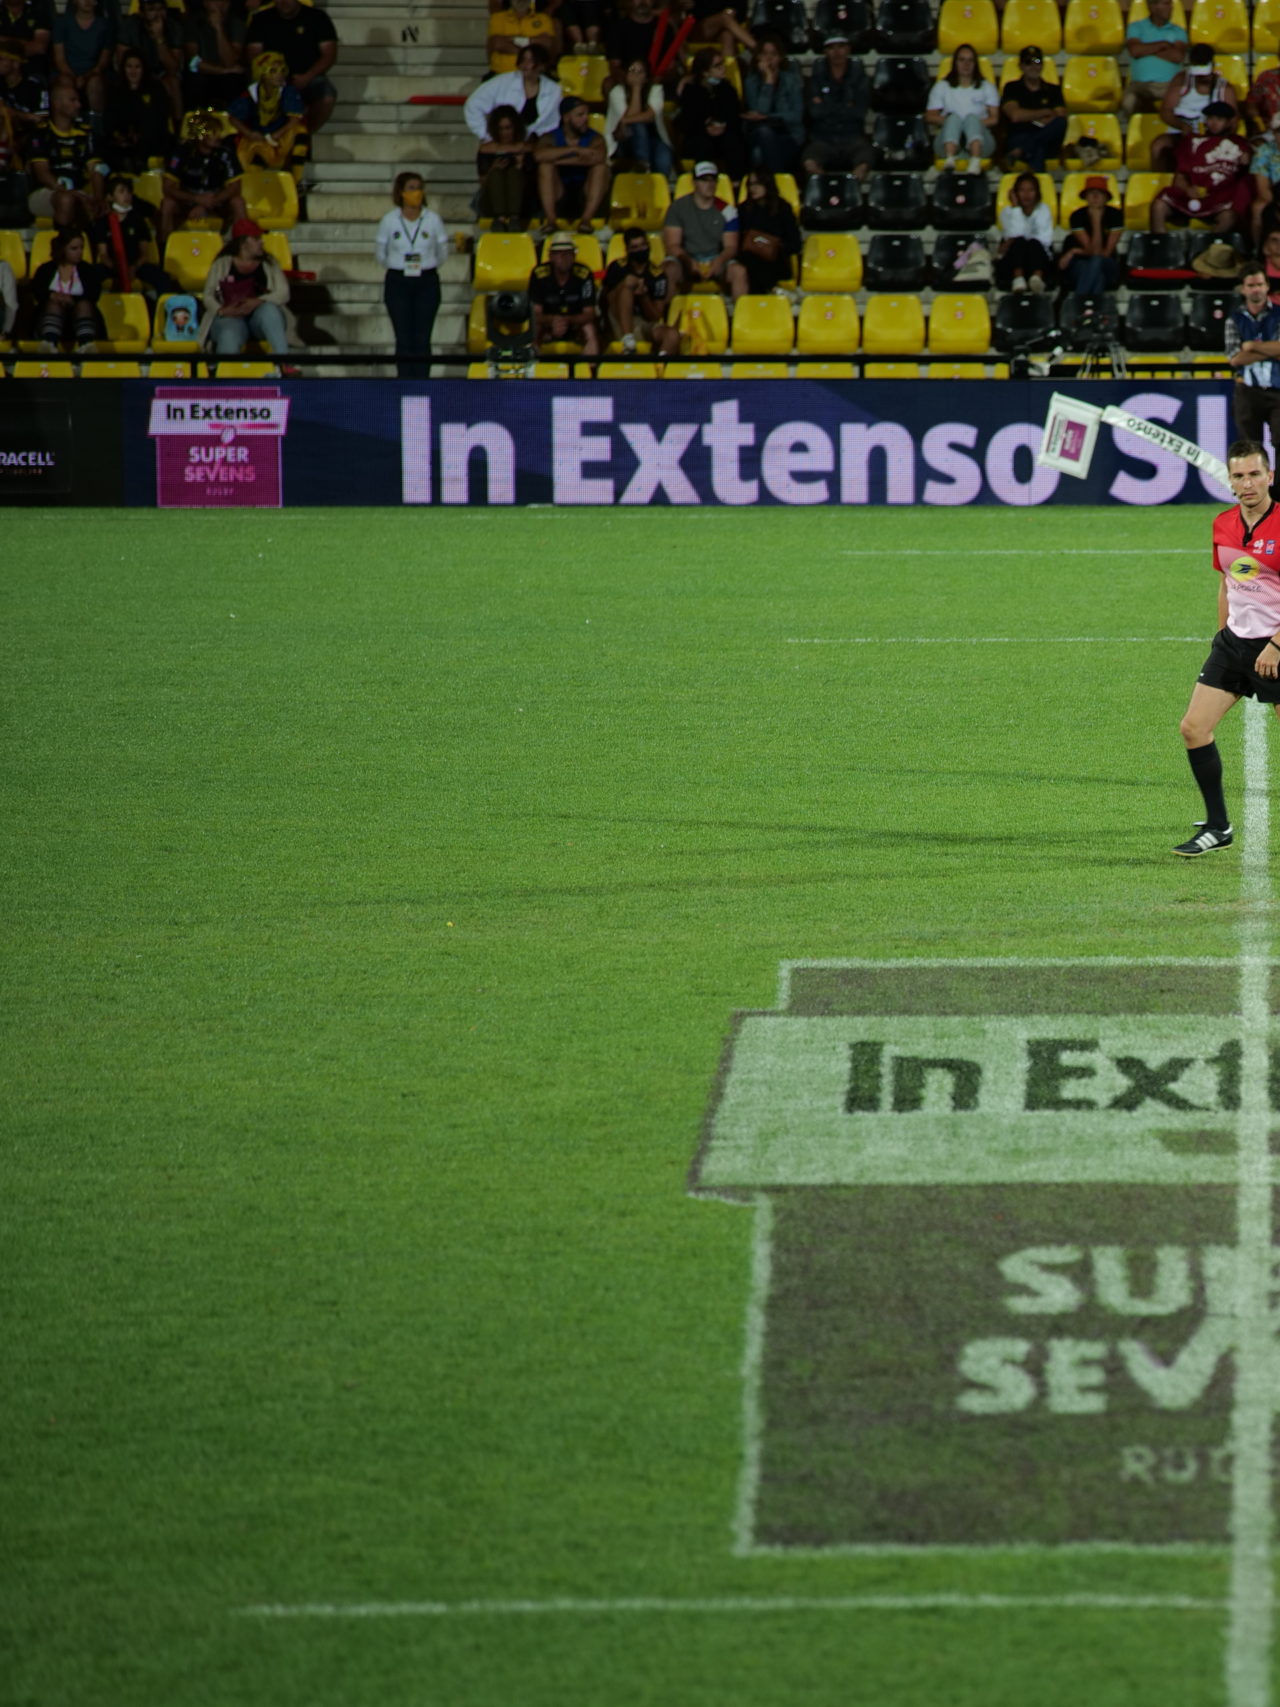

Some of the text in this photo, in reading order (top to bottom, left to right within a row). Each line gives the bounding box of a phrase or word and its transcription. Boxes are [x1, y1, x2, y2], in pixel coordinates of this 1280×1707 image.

[166, 403, 271, 420] In Extenso
[1127, 417, 1185, 453] Extenso
[189, 446, 249, 463] SUPER
[402, 397, 515, 503] In
[553, 397, 1062, 505] Extenso
[184, 465, 255, 482] SEVENS
[844, 1039, 983, 1113] In
